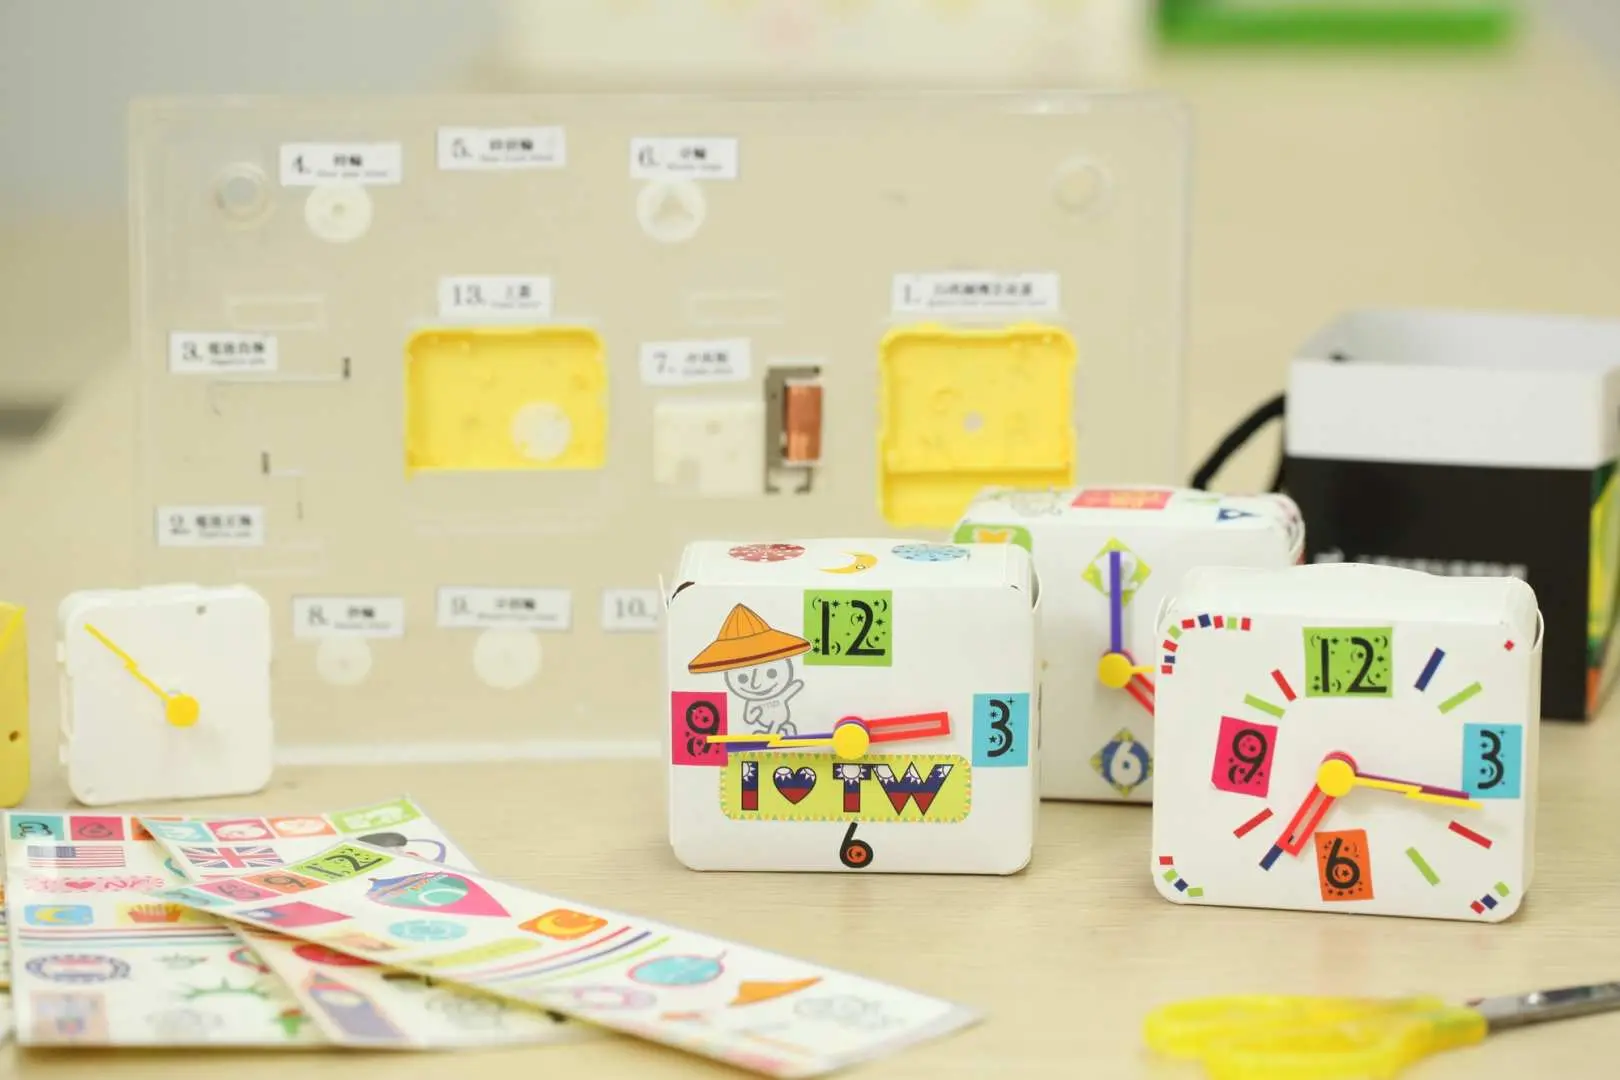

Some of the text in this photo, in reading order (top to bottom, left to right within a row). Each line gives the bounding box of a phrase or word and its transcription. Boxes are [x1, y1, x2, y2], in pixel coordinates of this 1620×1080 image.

[821, 600, 886, 656] 12
[1321, 636, 1387, 693] 12
[686, 700, 720, 755] 9
[987, 699, 1013, 758] 3
[1110, 740, 1142, 786] 6
[1232, 728, 1268, 783] 9
[1477, 729, 1504, 789] 3
[741, 761, 954, 816] I TW
[839, 821, 874, 868] 6
[1326, 837, 1361, 888] 6
